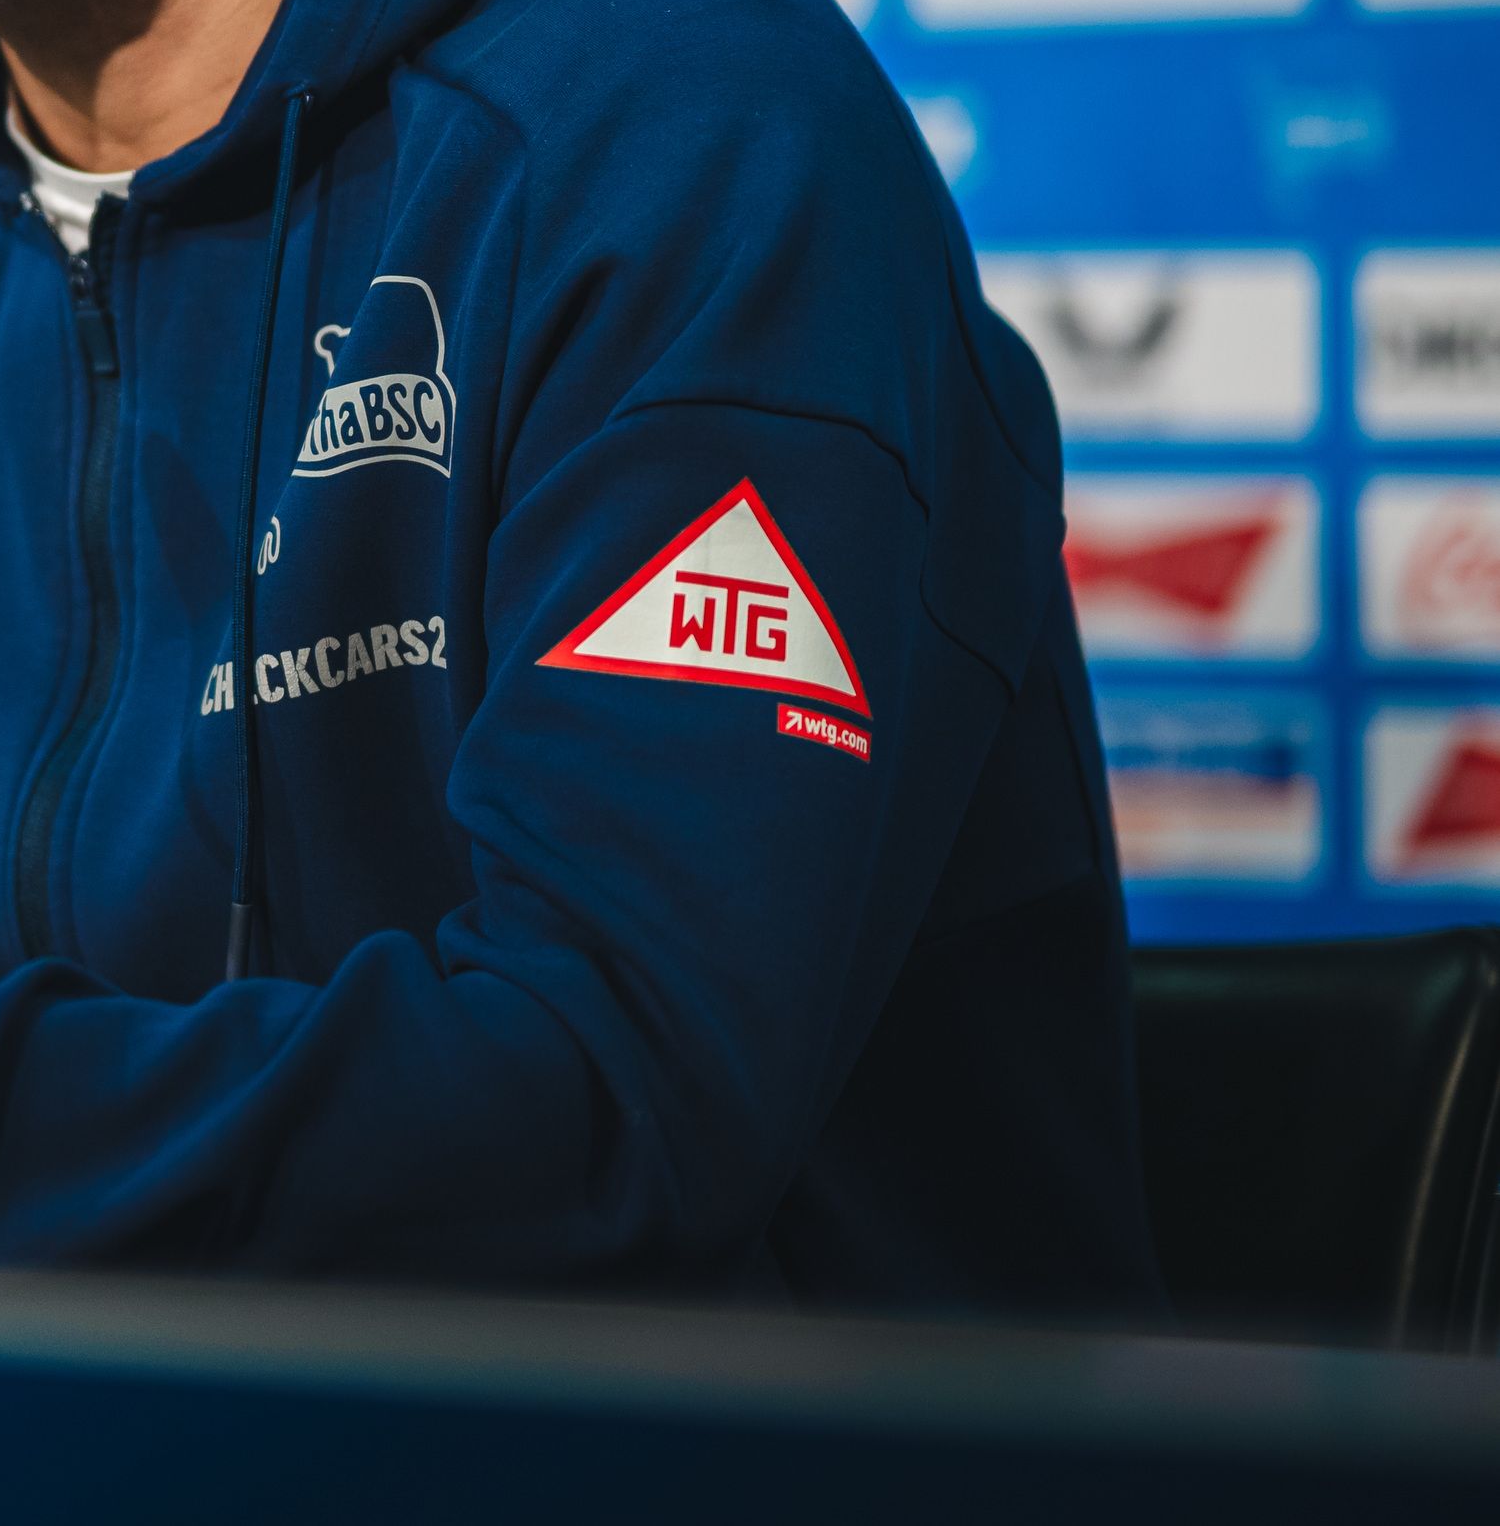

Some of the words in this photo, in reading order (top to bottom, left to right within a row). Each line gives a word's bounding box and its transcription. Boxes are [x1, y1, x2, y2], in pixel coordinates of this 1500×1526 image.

[669, 570, 790, 662] WTG
[201, 615, 447, 717] CHCKCARS2
[804, 716, 869, 755] wtg.com
